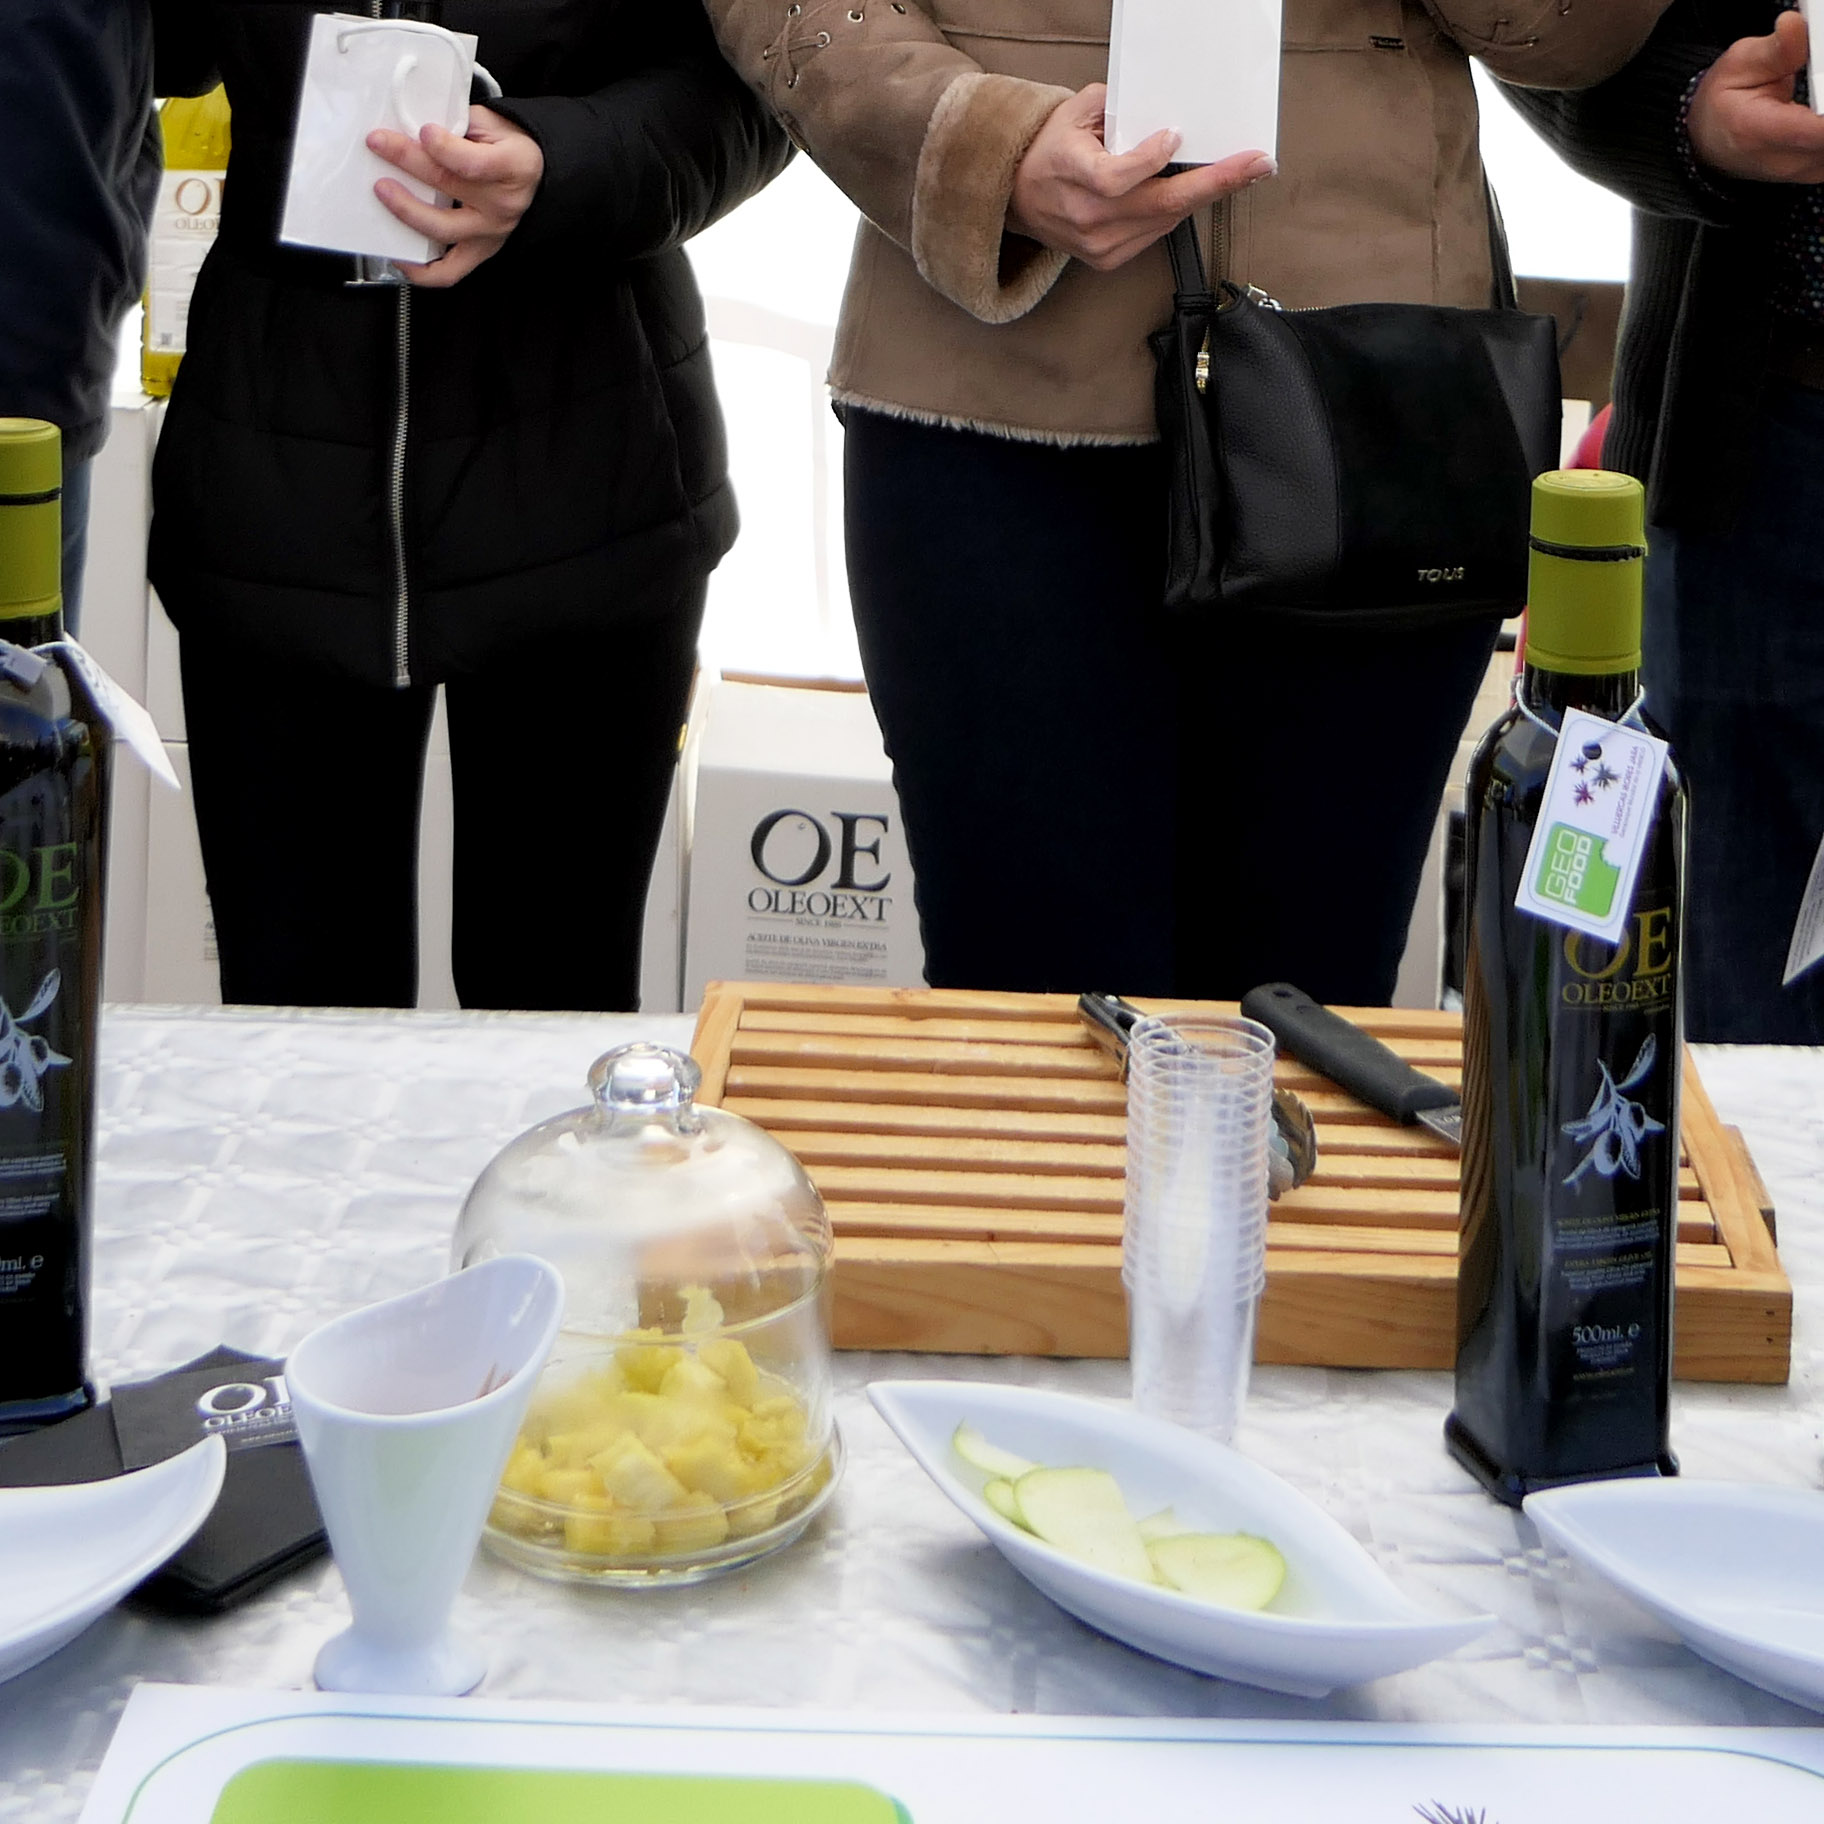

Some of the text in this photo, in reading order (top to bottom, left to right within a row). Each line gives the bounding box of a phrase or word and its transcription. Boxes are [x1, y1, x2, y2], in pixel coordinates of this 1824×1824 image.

[750, 808, 892, 893] OE
[1545, 829, 1578, 898] GEO
[1564, 835, 1592, 905] FOOD
[748, 887, 893, 921] OLEOEXT
[1564, 906, 1671, 979] OE
[1562, 973, 1672, 1004] OLEOEXT
